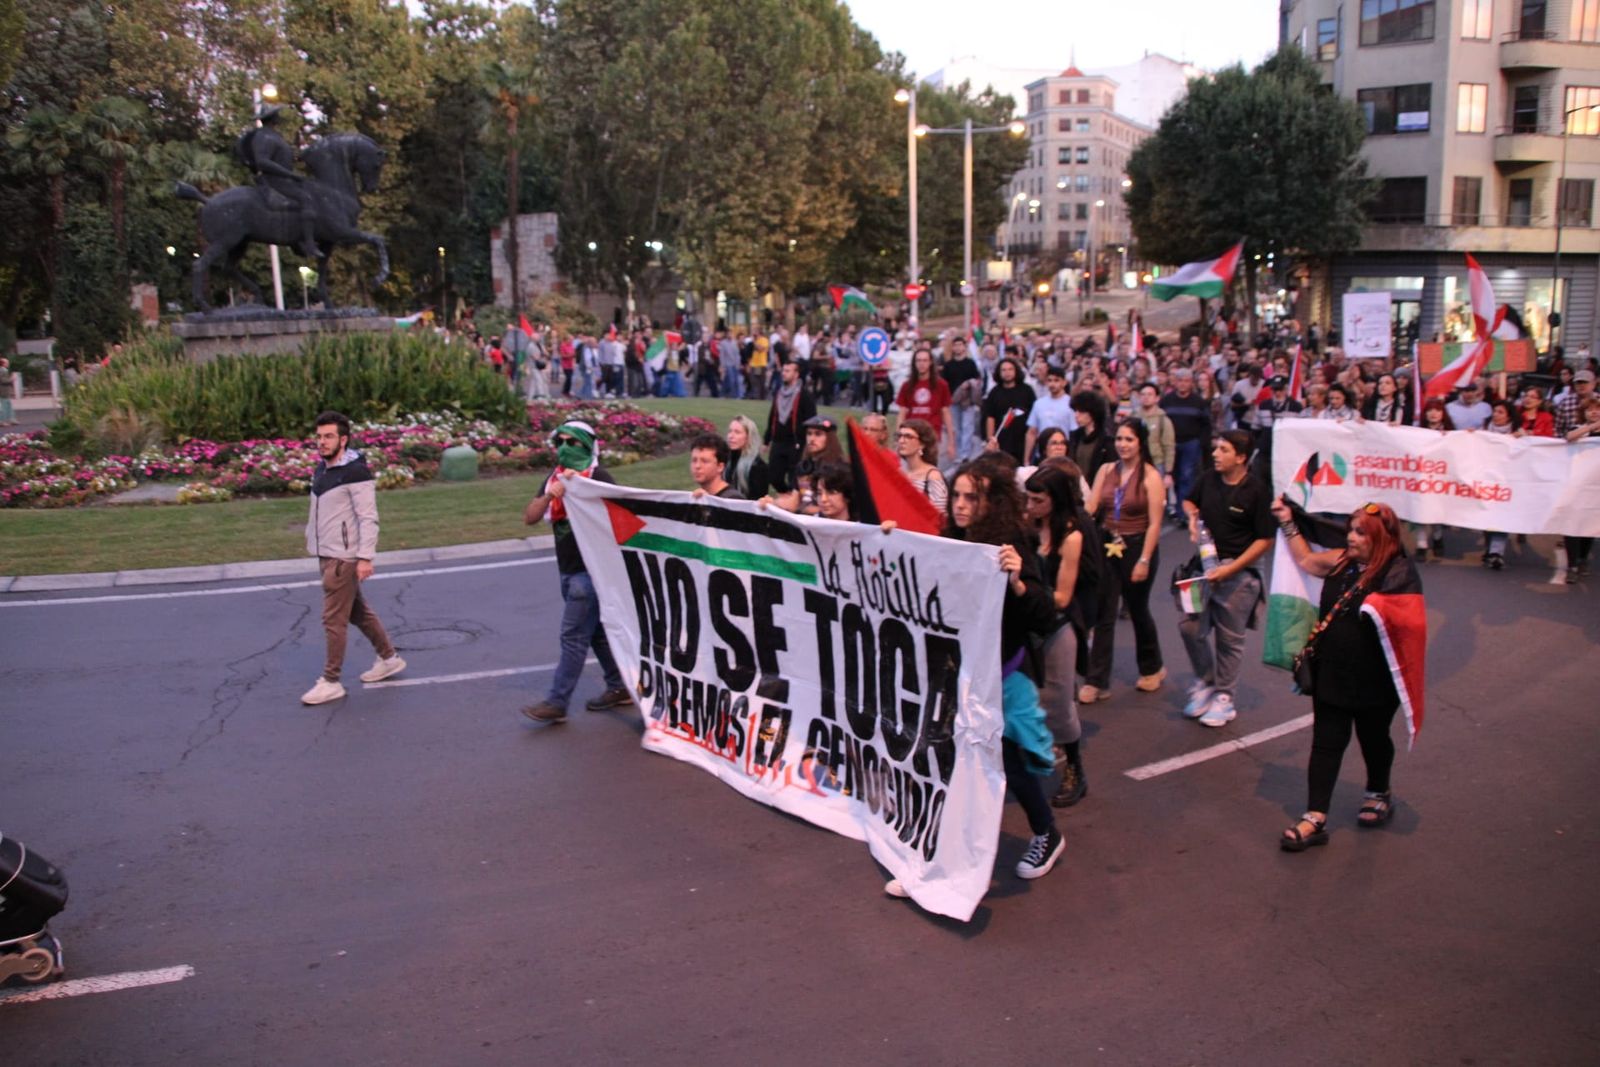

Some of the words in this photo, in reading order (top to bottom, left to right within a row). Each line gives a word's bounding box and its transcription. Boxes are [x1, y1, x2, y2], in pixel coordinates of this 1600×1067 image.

[1354, 453, 1447, 475] asamblea
[1354, 473, 1512, 503] internacionalista
[807, 530, 850, 599] la
[622, 550, 700, 675] NO
[708, 569, 789, 703] SE
[804, 588, 961, 784] TOCA
[639, 659, 749, 758] PAREMOS
[755, 704, 792, 768] EL
[799, 718, 947, 862] GENOCIDIO
